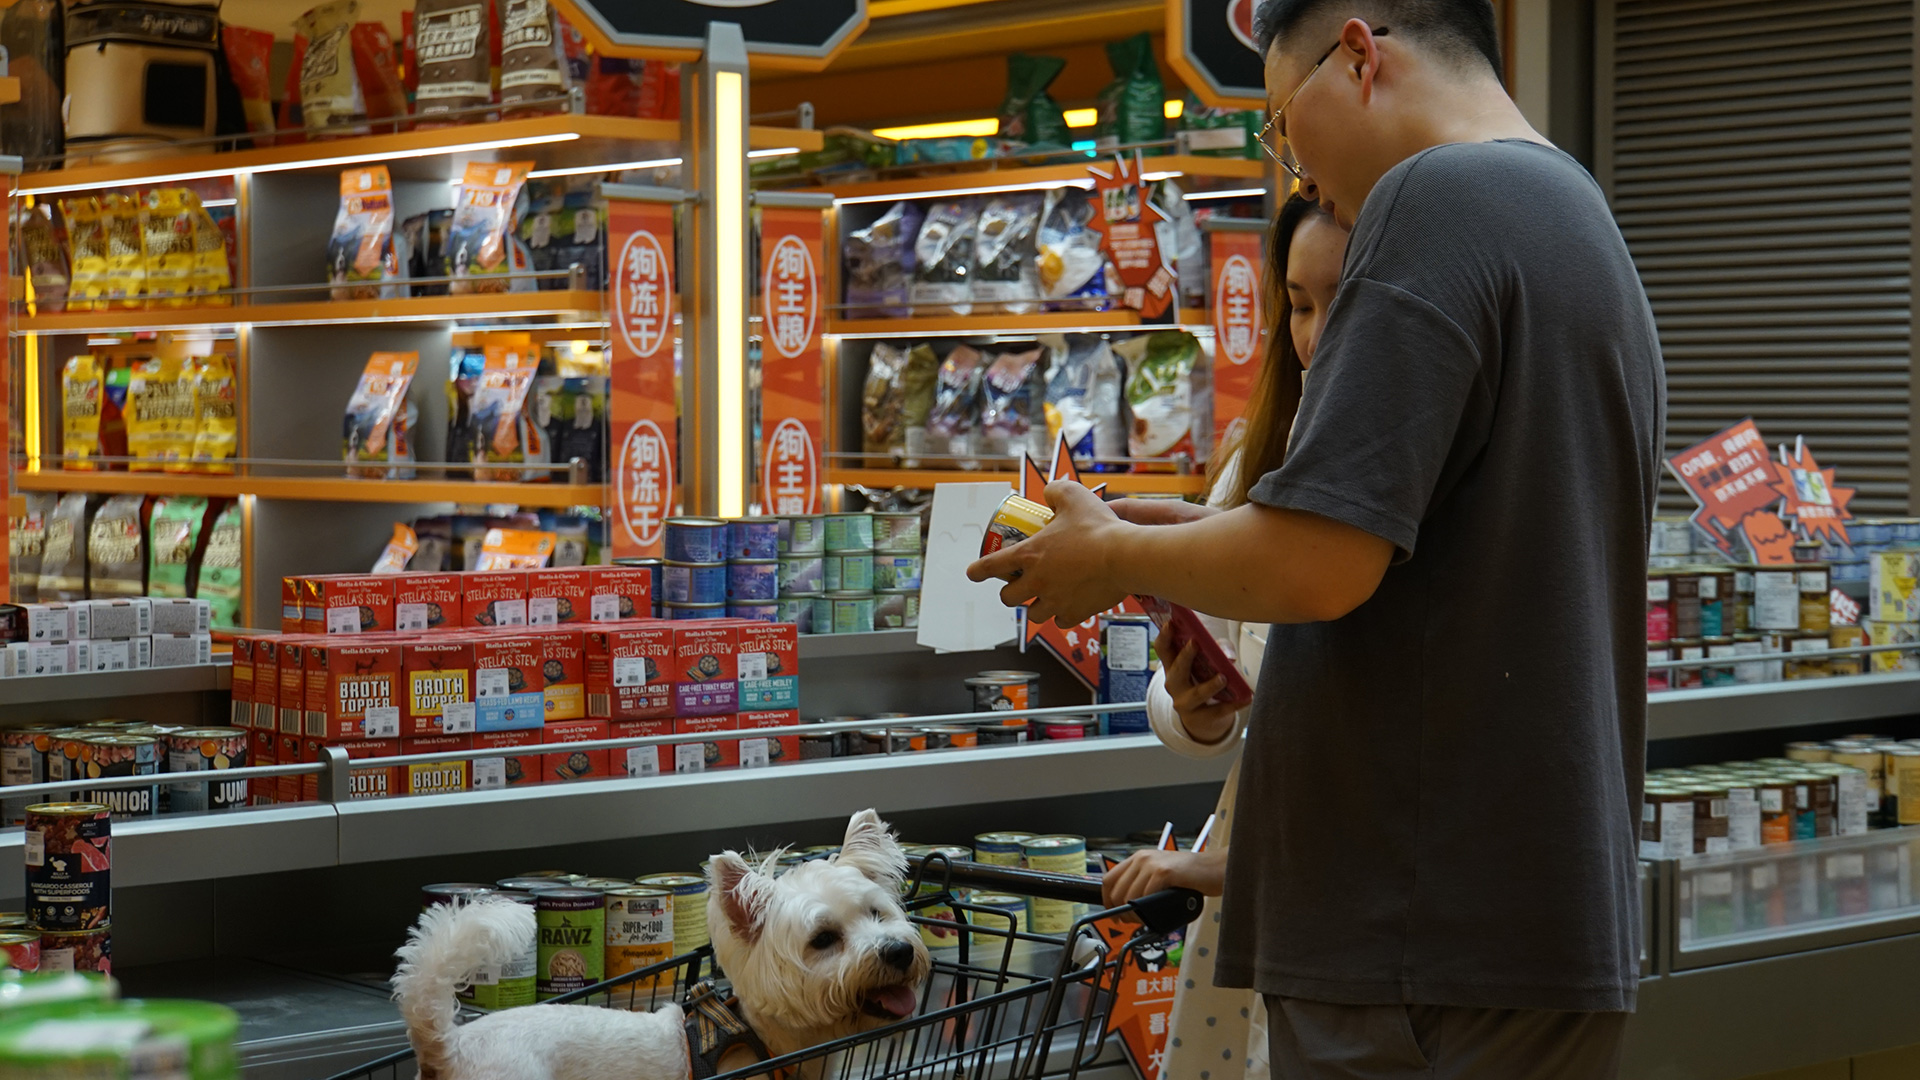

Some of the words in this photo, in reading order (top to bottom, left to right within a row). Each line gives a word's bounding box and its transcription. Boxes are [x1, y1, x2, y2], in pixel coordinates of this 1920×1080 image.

[629, 246, 659, 351] 狗冻干
[778, 246, 805, 348] 狗主粮
[631, 433, 660, 540] 狗冻干
[400, 591, 432, 604] STELLA'S
[435, 590, 456, 603] STEW
[467, 588, 498, 602] STELLA'S
[501, 588, 521, 600] STEW
[532, 586, 563, 598] STELLA'S
[565, 585, 586, 597] STEW
[594, 584, 624, 595] STELLA'S
[626, 584, 646, 596] STEW
[329, 594, 364, 607] STELLA'S
[366, 593, 389, 606] STEW
[364, 647, 389, 655] Chewy's
[557, 647, 578, 659] STEW
[613, 645, 645, 658] STELLA'S
[648, 644, 669, 656] STEW
[678, 643, 709, 657] STELLA'S
[712, 643, 733, 654] STEW
[740, 640, 771, 653] STELLA'S
[773, 639, 793, 651] STEW
[478, 655, 513, 669] STELLA'S
[516, 654, 538, 666] STEW
[340, 680, 390, 698] BROTH
[415, 677, 464, 696] BROTH
[648, 684, 669, 693] MEDLEY
[773, 678, 792, 687] MEDLEY
[340, 697, 390, 712] TOPPER
[415, 694, 463, 709] TOPPER
[413, 770, 461, 788] BROTH
[215, 778, 247, 804] JUNI
[92, 790, 149, 812] JUNIOR
[623, 921, 641, 933] SUPER
[648, 920, 663, 932] FOOD
[541, 928, 592, 945] RAWZ
[1136, 975, 1178, 995] 意大利
[1149, 1012, 1171, 1035] 看
